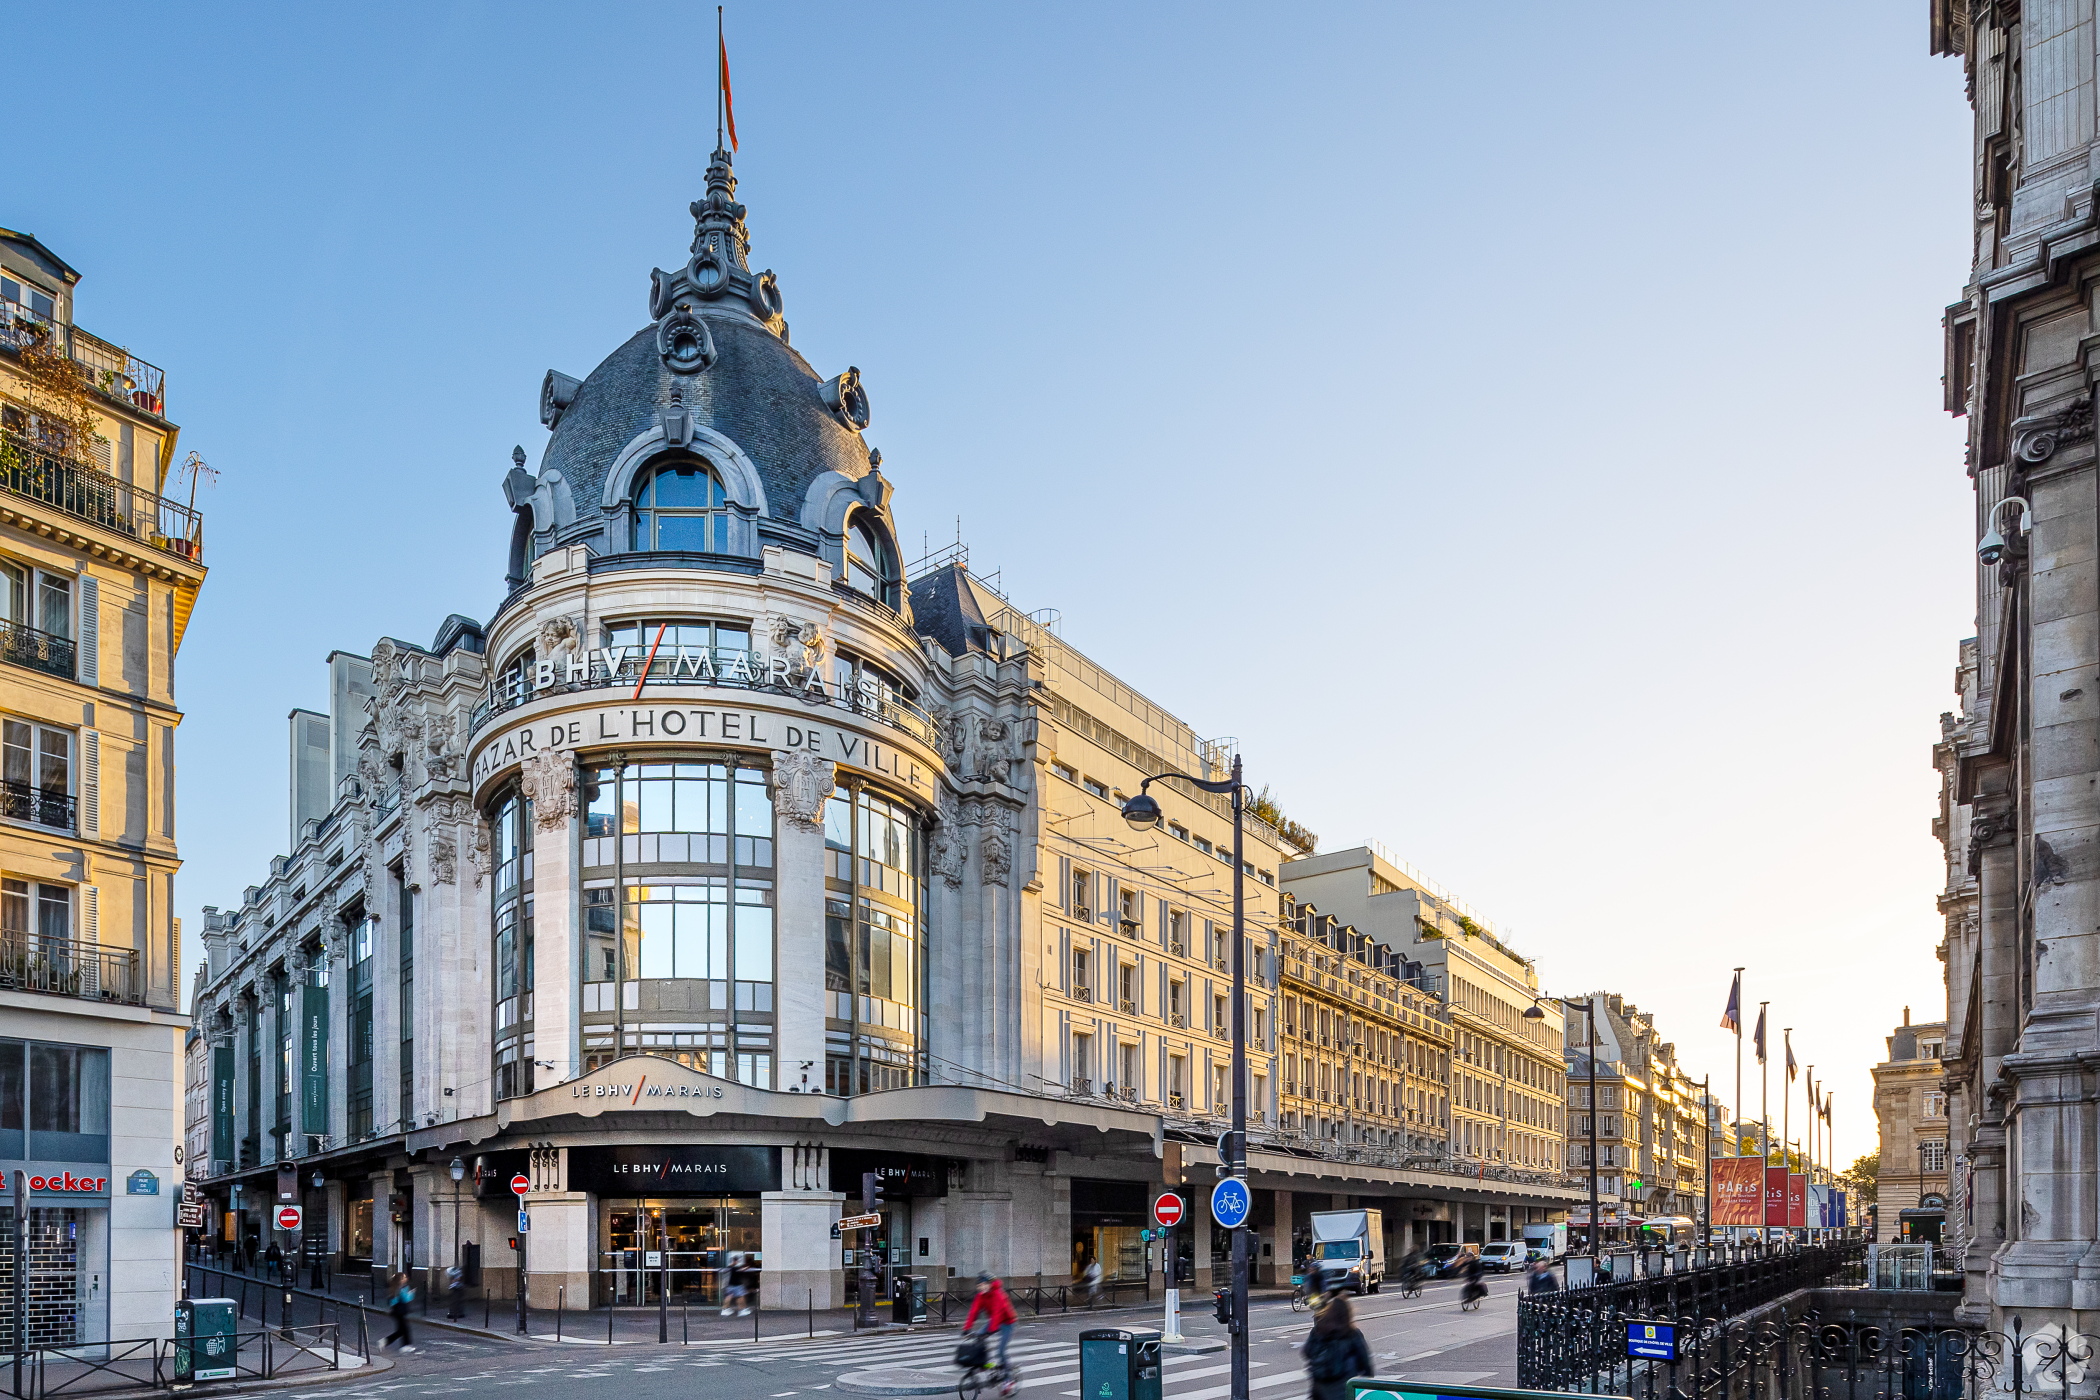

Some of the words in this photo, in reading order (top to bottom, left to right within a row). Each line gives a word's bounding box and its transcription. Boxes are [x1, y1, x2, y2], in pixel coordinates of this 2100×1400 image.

[487, 668, 518, 710] LE
[536, 646, 627, 691] BHV
[673, 645, 874, 708] MARAIS
[475, 729, 537, 789] BAZAR
[551, 722, 581, 747] DE
[599, 709, 767, 742] L'HOTEL
[786, 726, 821, 752] DE
[837, 732, 920, 790] VILLE
[311, 1015, 320, 1030] jours
[572, 1085, 590, 1098] LE
[595, 1084, 633, 1097] BHV
[646, 1084, 724, 1099] MARAIS
[613, 1164, 629, 1173] LE
[671, 1164, 727, 1173] MARAIS
[29, 1171, 108, 1192] ocker
